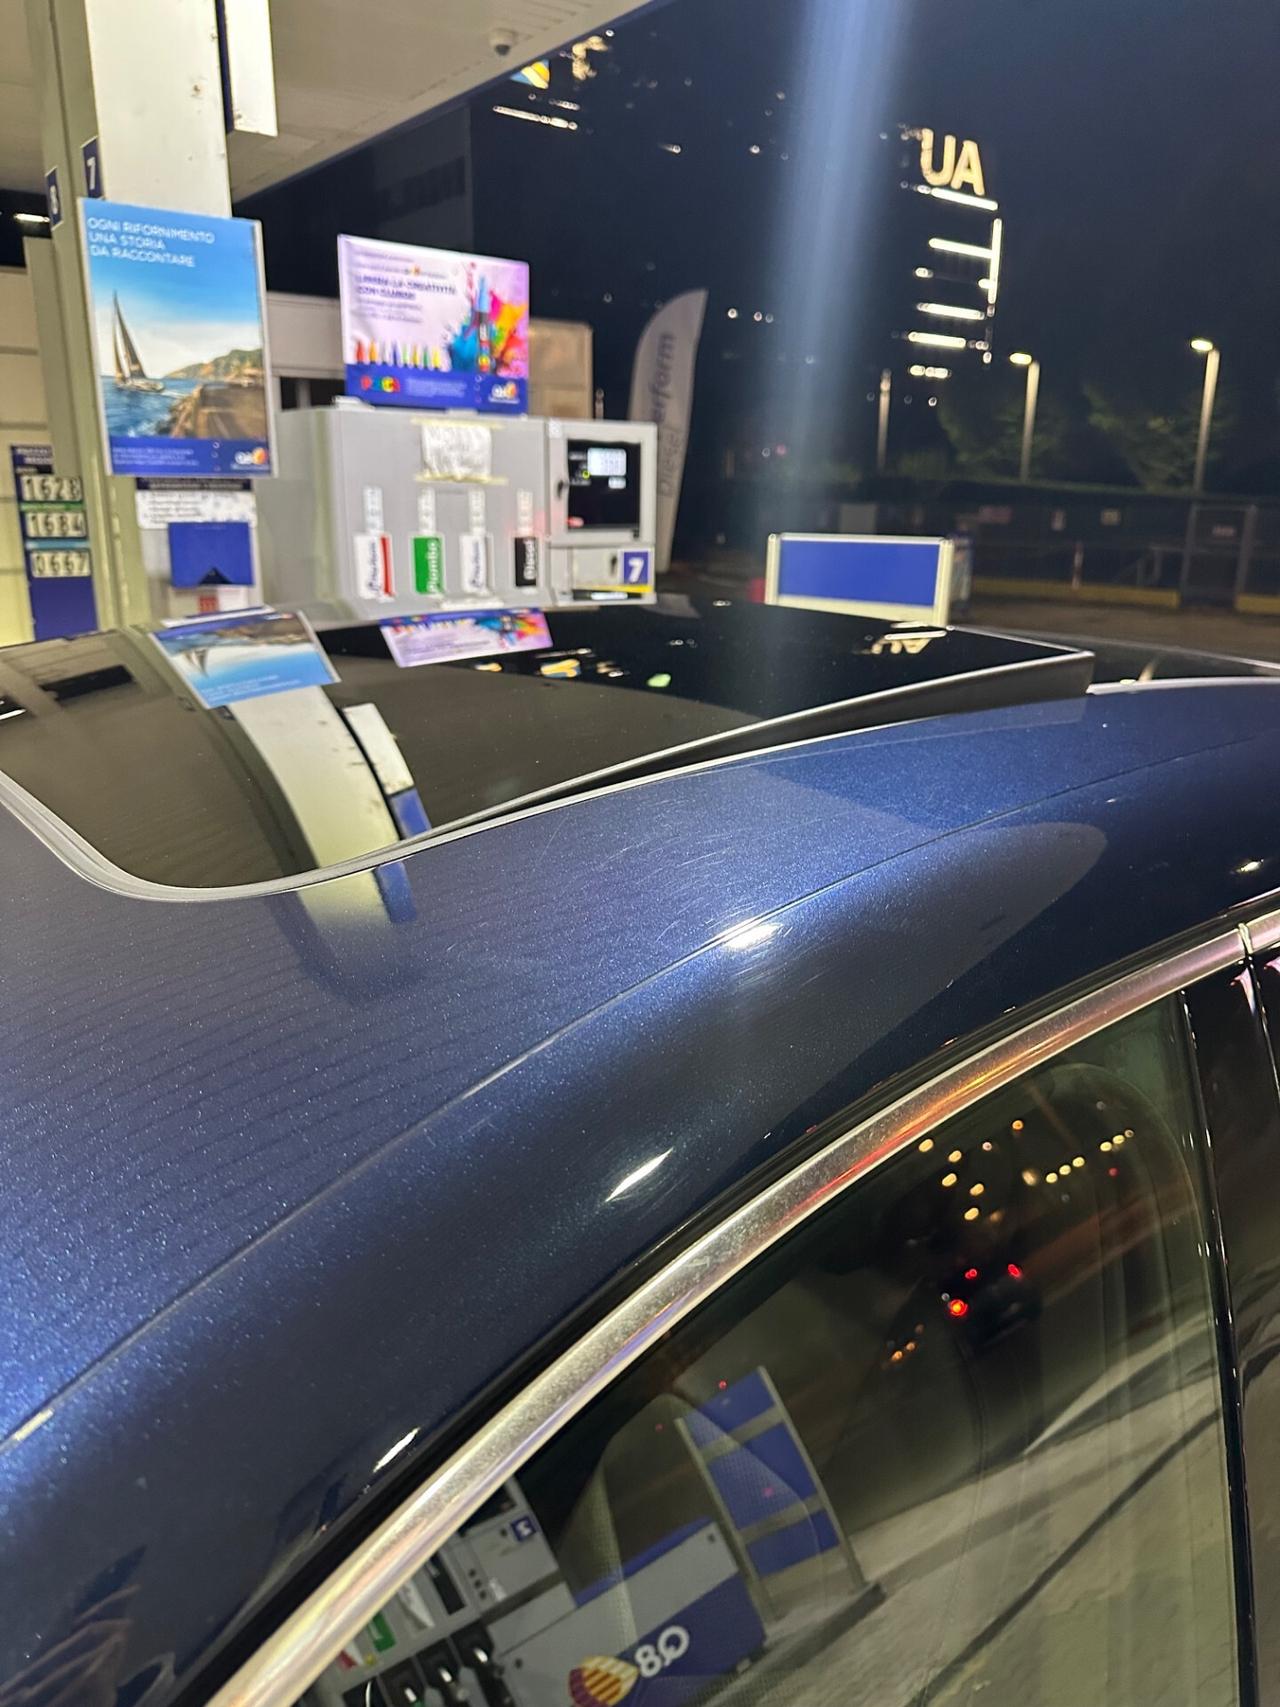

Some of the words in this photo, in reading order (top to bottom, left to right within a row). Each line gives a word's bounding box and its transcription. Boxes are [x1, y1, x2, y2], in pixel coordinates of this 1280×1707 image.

[920, 128, 986, 196] UA
[87, 217, 121, 231] OGNI
[122, 222, 215, 244] RIFORNIMENTO
[88, 231, 117, 244] UNA
[119, 234, 166, 250] STORIA
[90, 244, 110, 257] DA
[111, 247, 196, 268] RACCONTARE
[648, 332, 674, 424] erform
[628, 556, 645, 584] 7
